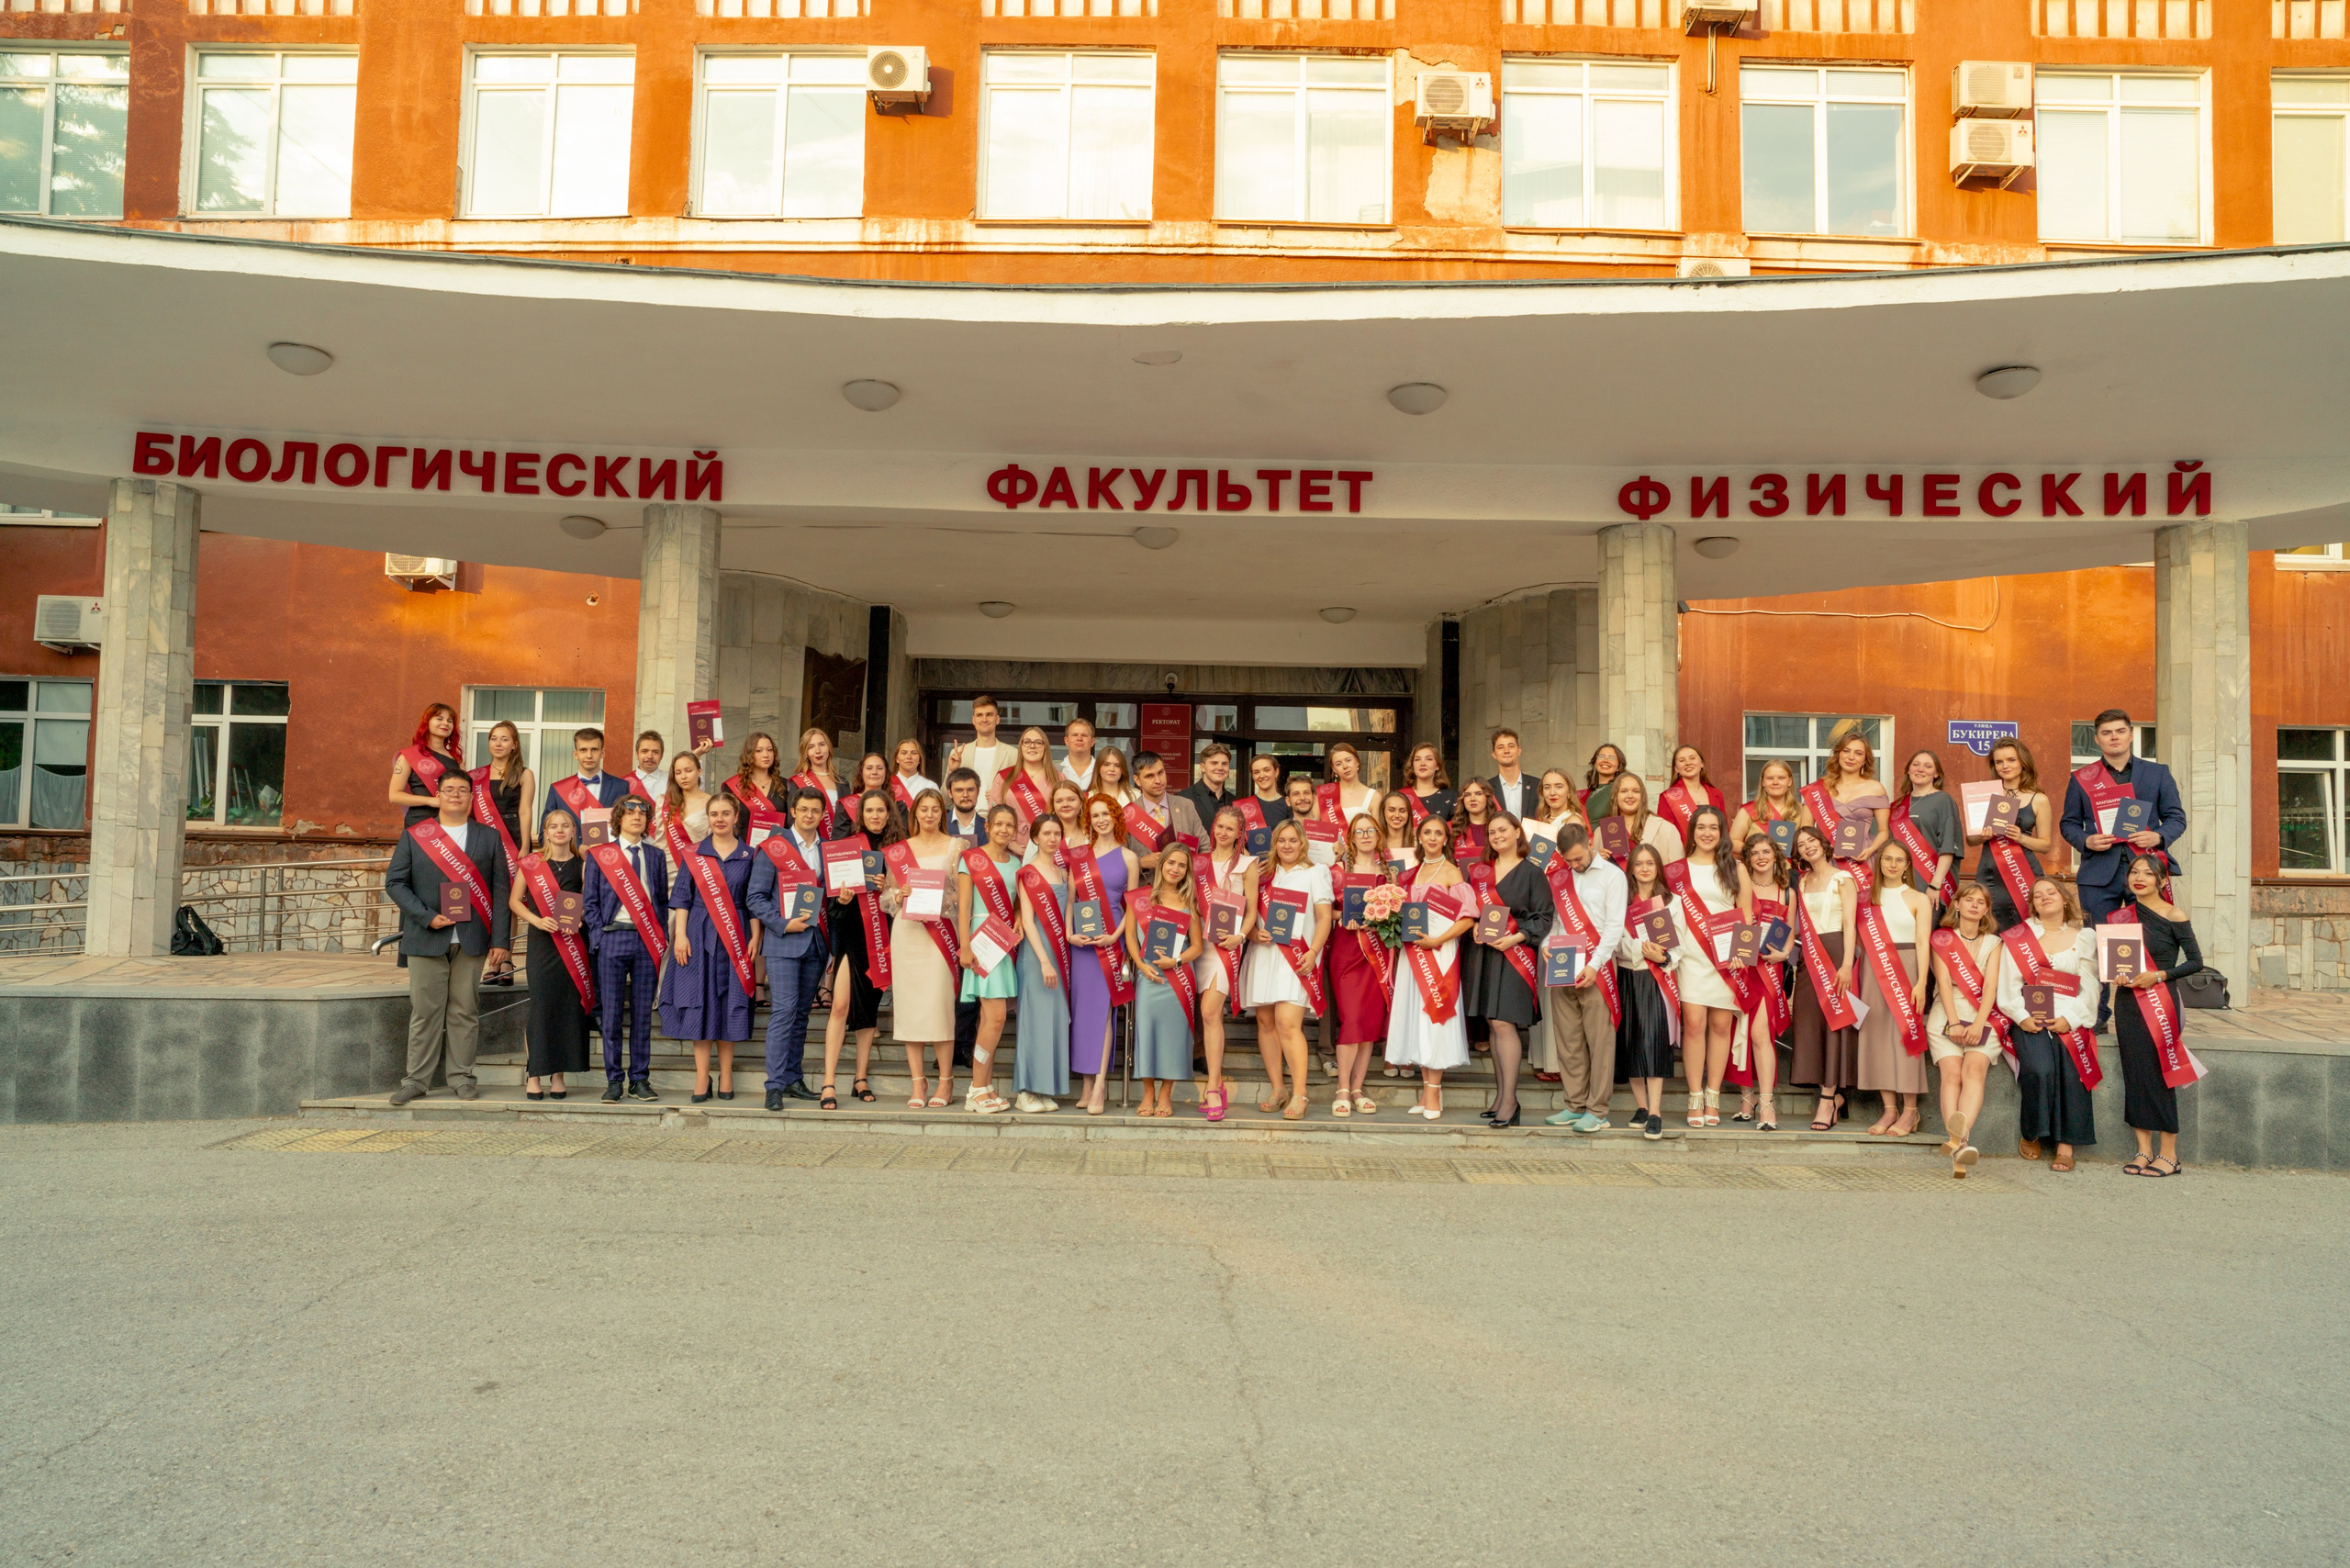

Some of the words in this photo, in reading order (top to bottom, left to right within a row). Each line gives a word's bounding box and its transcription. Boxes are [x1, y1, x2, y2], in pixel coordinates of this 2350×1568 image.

[133, 431, 723, 501] БИОЛОГИЧЕСКИЙ
[987, 464, 1373, 512] ФАКУЛЬТЕТ
[1618, 461, 2211, 521] ФИЗИЧЕСКИЙ
[1953, 729, 2014, 738] БУКИРЕВА
[1978, 741, 1990, 750] 15
[1811, 790, 1835, 828] ЛУЧШИЙ
[1305, 830, 1335, 838] БЛАГОДАРНОСТЬ
[1897, 823, 1930, 863] ЛУЧШИЙ
[431, 837, 466, 875] ЛУЧШИЙ
[615, 868, 644, 911] ЛУЧШИЙ
[984, 876, 1010, 923] ЛУЧШИЙ
[1427, 898, 1455, 915] БЛАГОДАРНОСТЬ
[695, 856, 721, 896] ЛУЧШИЙ
[713, 897, 743, 958] ВЫПУСКНИК
[739, 958, 751, 980] 2024
[1037, 891, 1063, 937] ЛУЧШИЙ
[1560, 889, 1583, 934] ЛУЧШИЙ
[985, 924, 1010, 946] БЛАГОДАРНОСТЬ
[1676, 881, 1703, 923] ЛУЧШИЙ
[1735, 975, 1749, 998] 2024
[877, 952, 888, 973] 2024
[1113, 970, 1125, 991] 2024
[1805, 931, 1833, 995] ВЫПУСКНИК
[1828, 993, 1843, 1015] 2024
[1863, 907, 1886, 950] ЛУЧШИЙ
[1878, 950, 1913, 1018] ВЫПУСКНИК
[1907, 1017, 1919, 1041] 2024
[1949, 950, 1984, 997] ЛУЧШИЙ
[583, 978, 591, 1000] 2024
[1311, 978, 1322, 1002] 2024
[1430, 987, 1444, 1008] 2024
[2079, 1051, 2092, 1074] 2024
[2166, 1044, 2181, 1071] 2024
